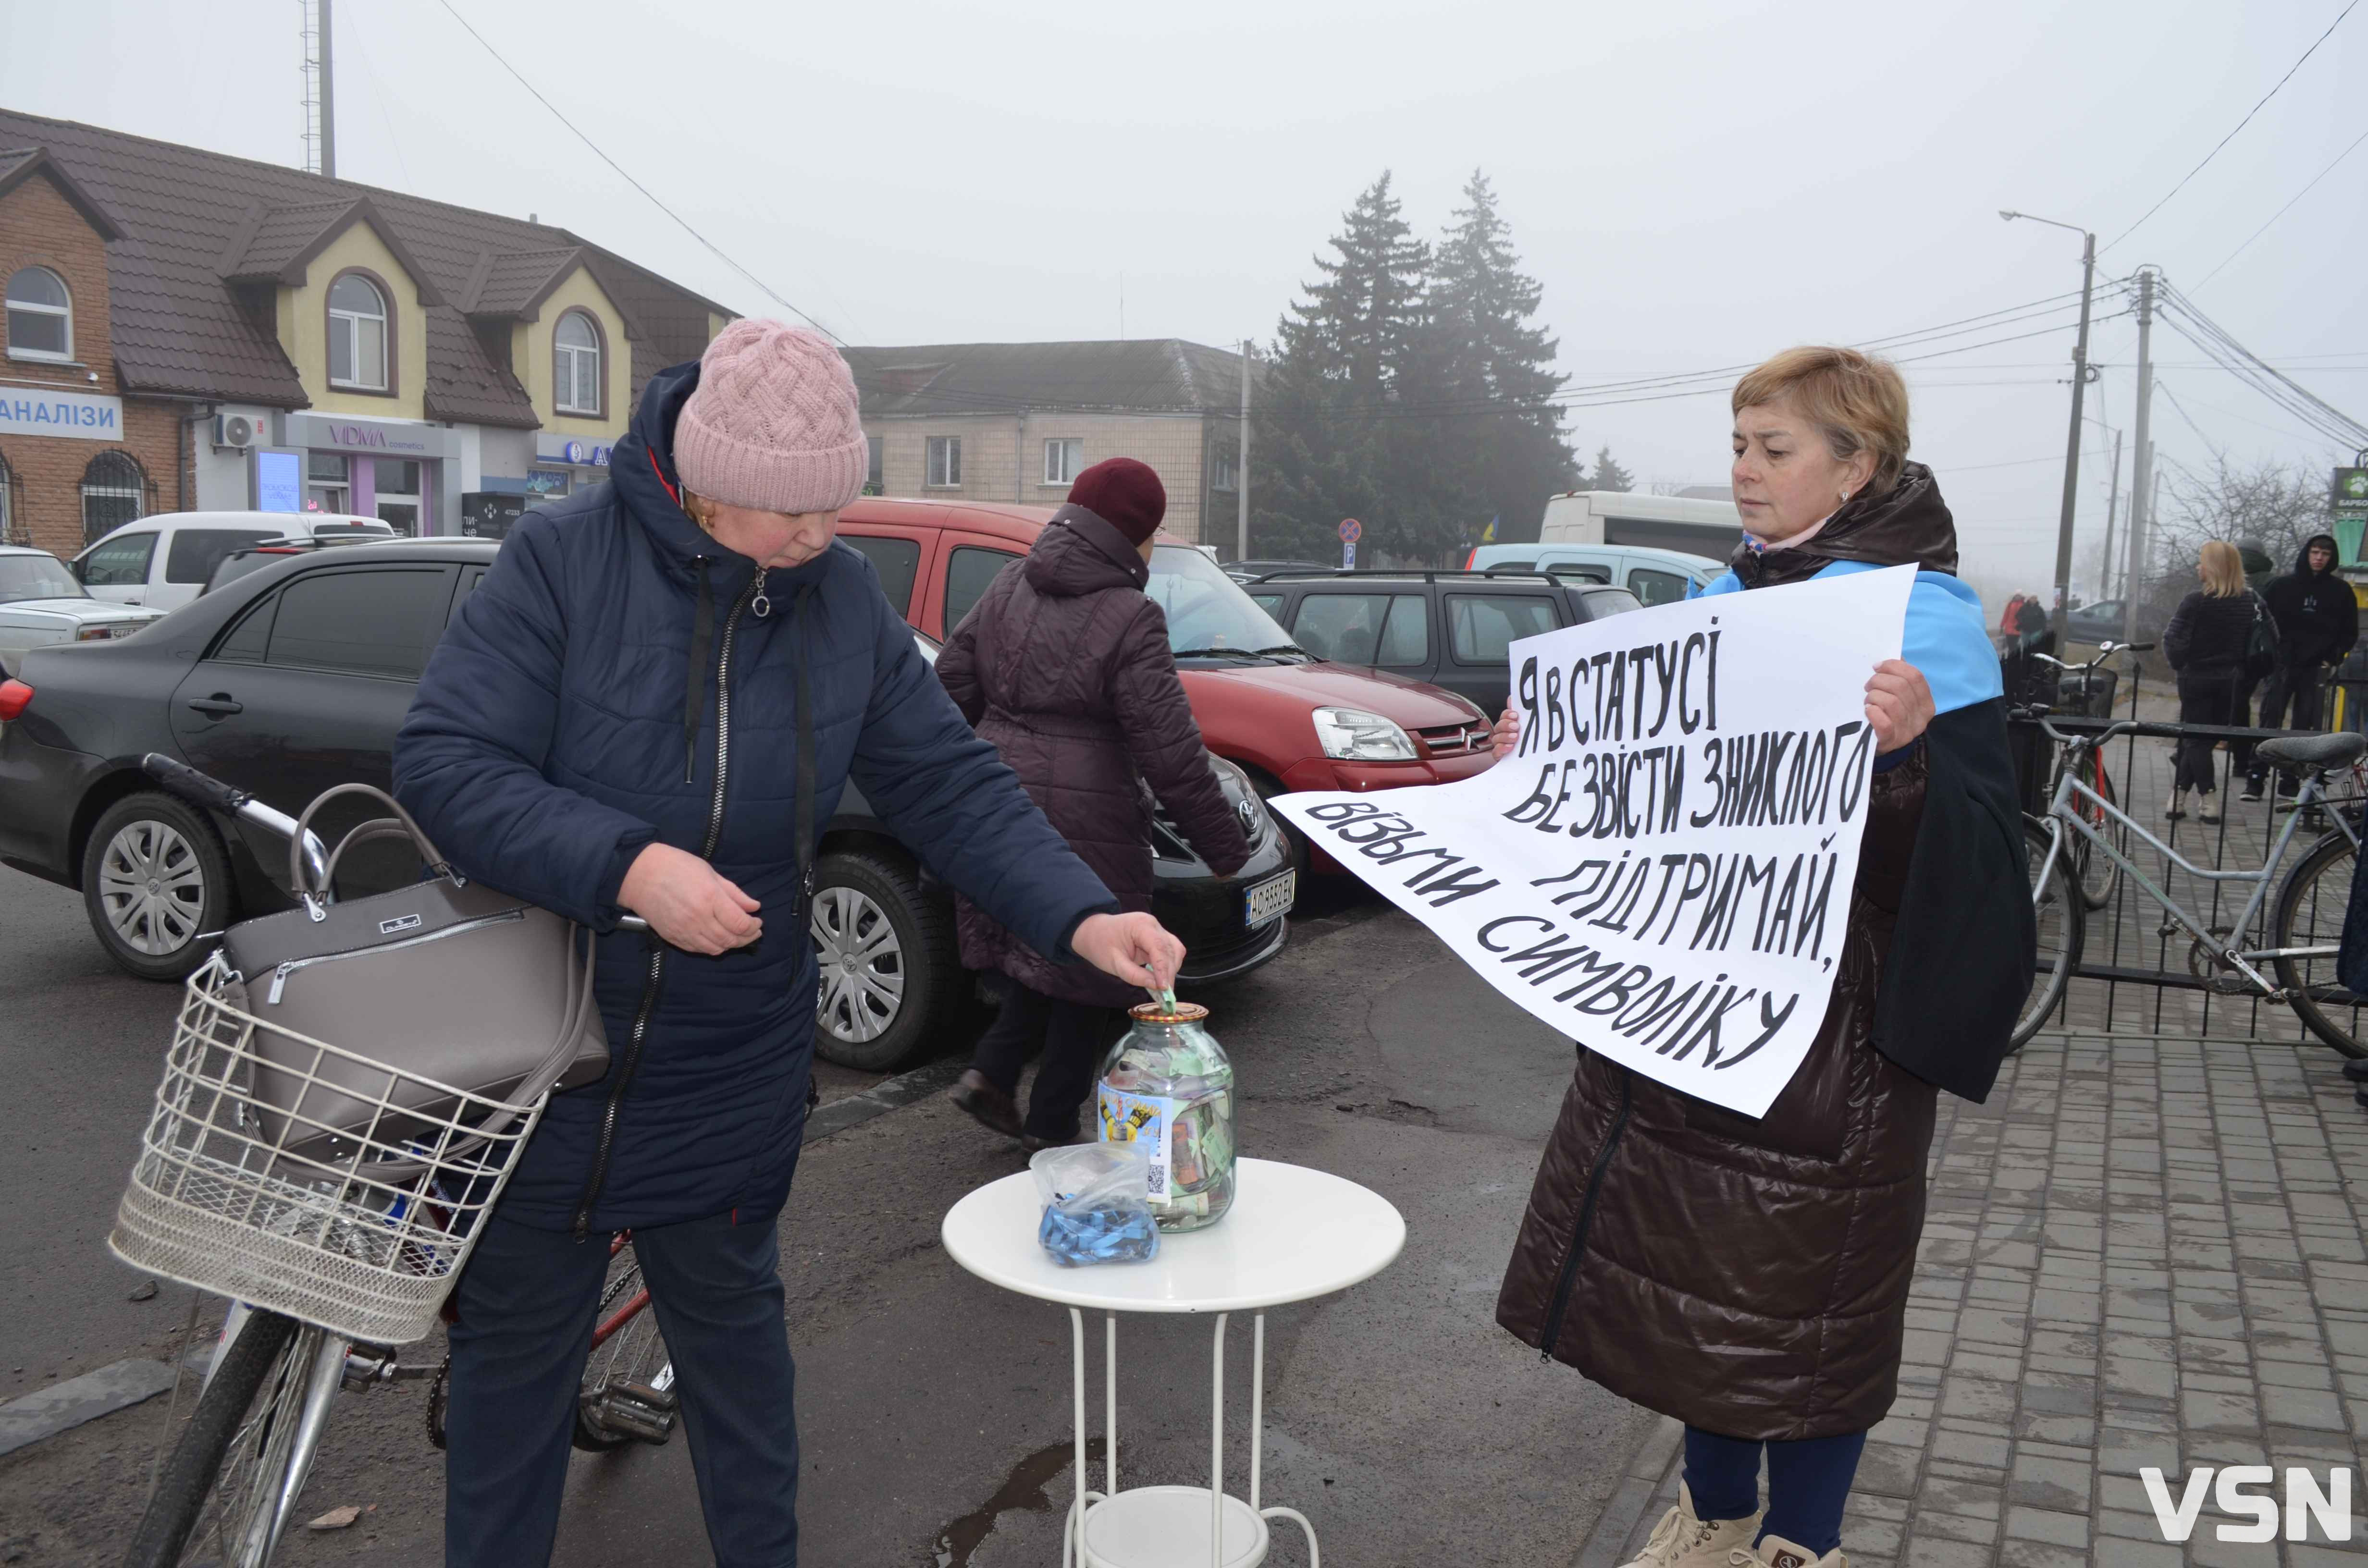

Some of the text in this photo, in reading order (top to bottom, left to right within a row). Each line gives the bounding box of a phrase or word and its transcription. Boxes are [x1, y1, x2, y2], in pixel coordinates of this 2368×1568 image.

[0, 399, 114, 428] АНАЛІЗИ
[330, 425, 424, 450] VIDMA cosmetics
[1346, 546, 1354, 563] P
[1519, 616, 1721, 758] Я В СТАТУСІ
[1690, 721, 1875, 828] ЗНИКЛОГО
[1251, 876, 1292, 919] AC 9552 EK
[1305, 803, 1800, 1070] ВІЗЬМИ СИМВОЛІКУ
